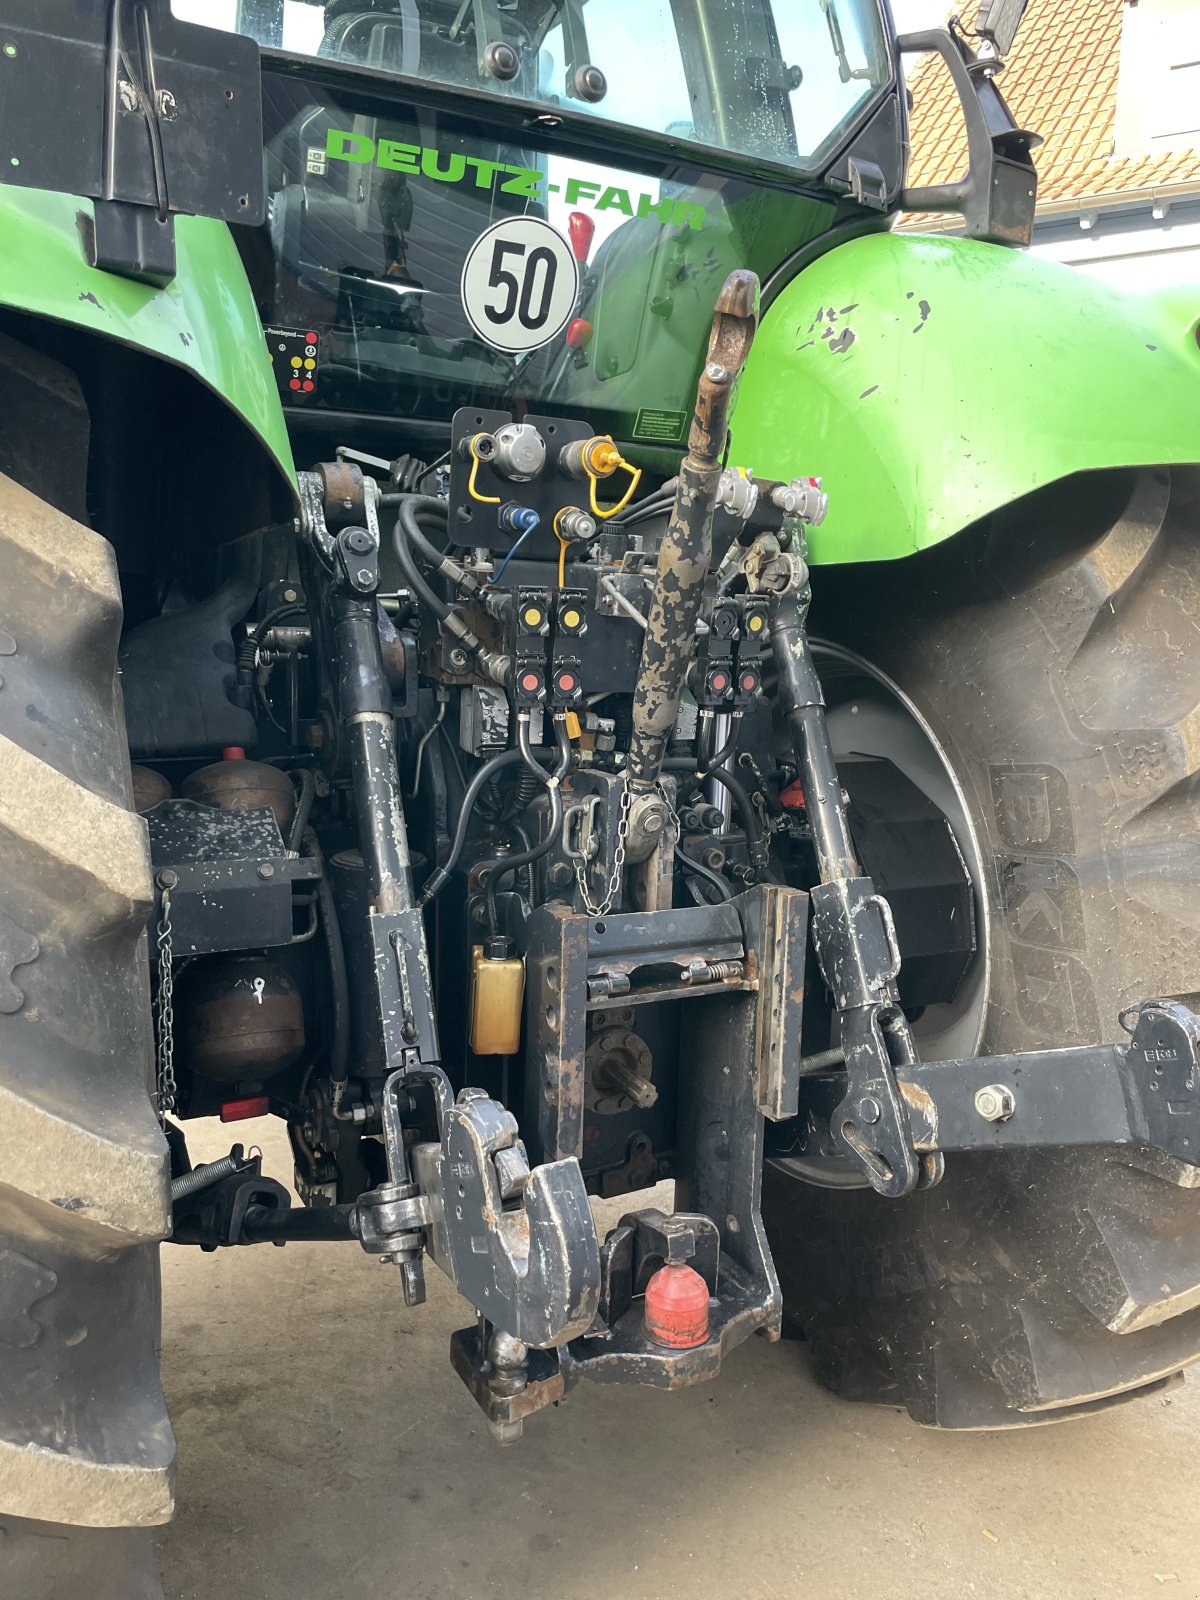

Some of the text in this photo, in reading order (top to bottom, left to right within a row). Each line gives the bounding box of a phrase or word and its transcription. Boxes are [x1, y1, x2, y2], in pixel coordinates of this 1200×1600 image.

[326, 128, 707, 231] DEUTZ-FAHR
[484, 239, 557, 330] 50
[293, 369, 312, 379] 3 4
